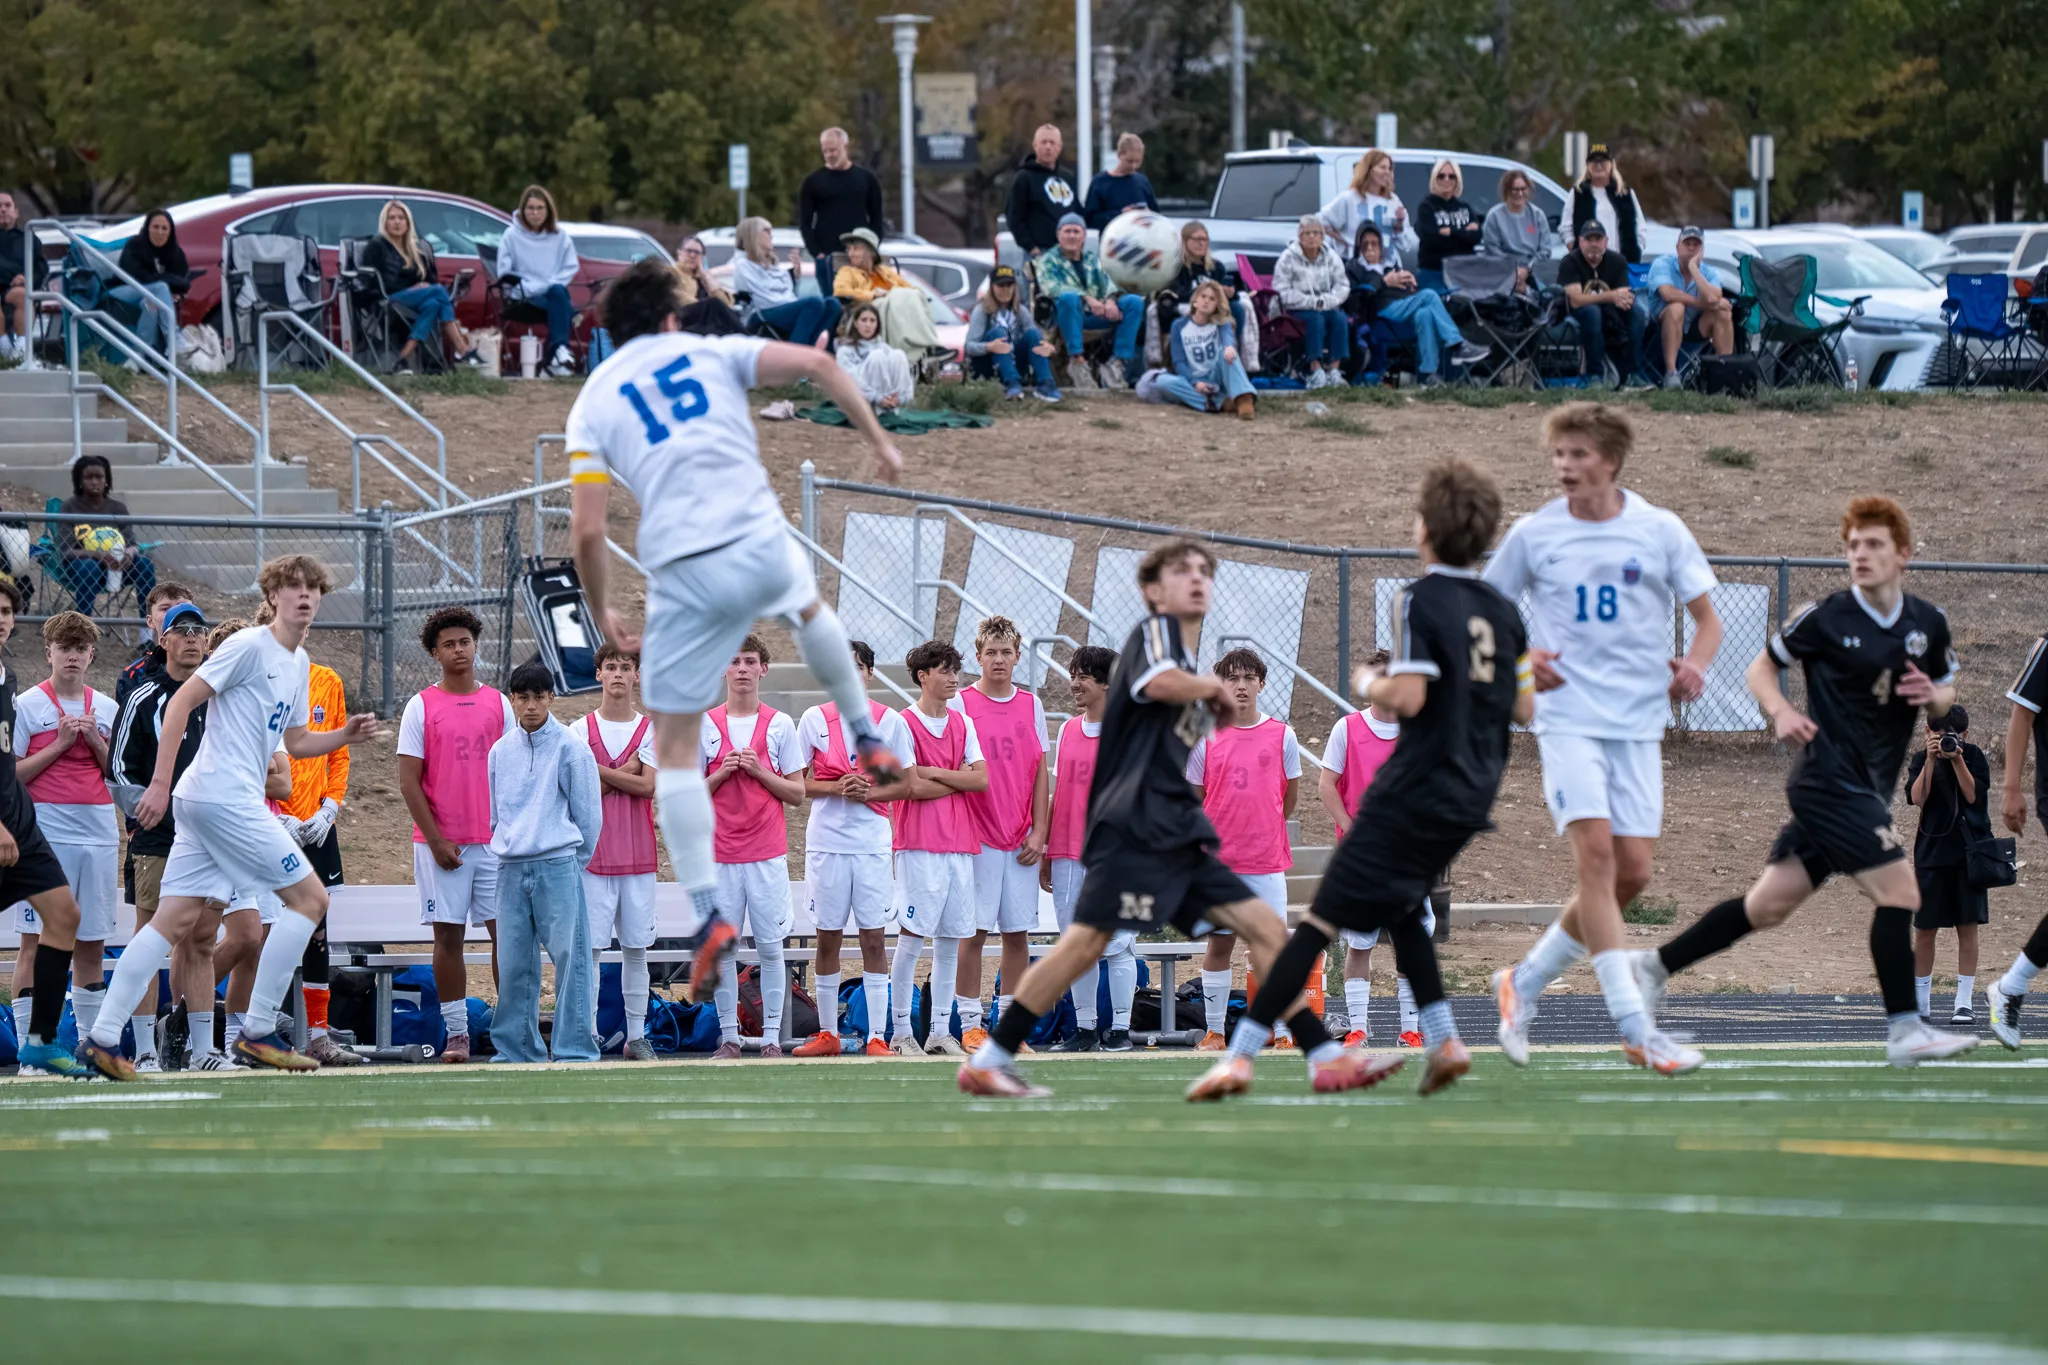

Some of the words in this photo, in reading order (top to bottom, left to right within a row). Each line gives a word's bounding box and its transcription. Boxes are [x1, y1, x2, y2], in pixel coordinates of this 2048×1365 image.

[1192, 341, 1216, 363] 98
[620, 354, 709, 445] 15
[1576, 584, 1618, 622] 18
[1467, 614, 1496, 683] 2
[1871, 667, 1893, 705] 4
[268, 701, 290, 734] 20
[455, 734, 487, 761] 24
[1234, 767, 1248, 790] 3
[281, 852, 300, 873] 20
[24, 908, 36, 922] 21
[906, 905, 915, 919] 9
[1118, 891, 1154, 921] M
